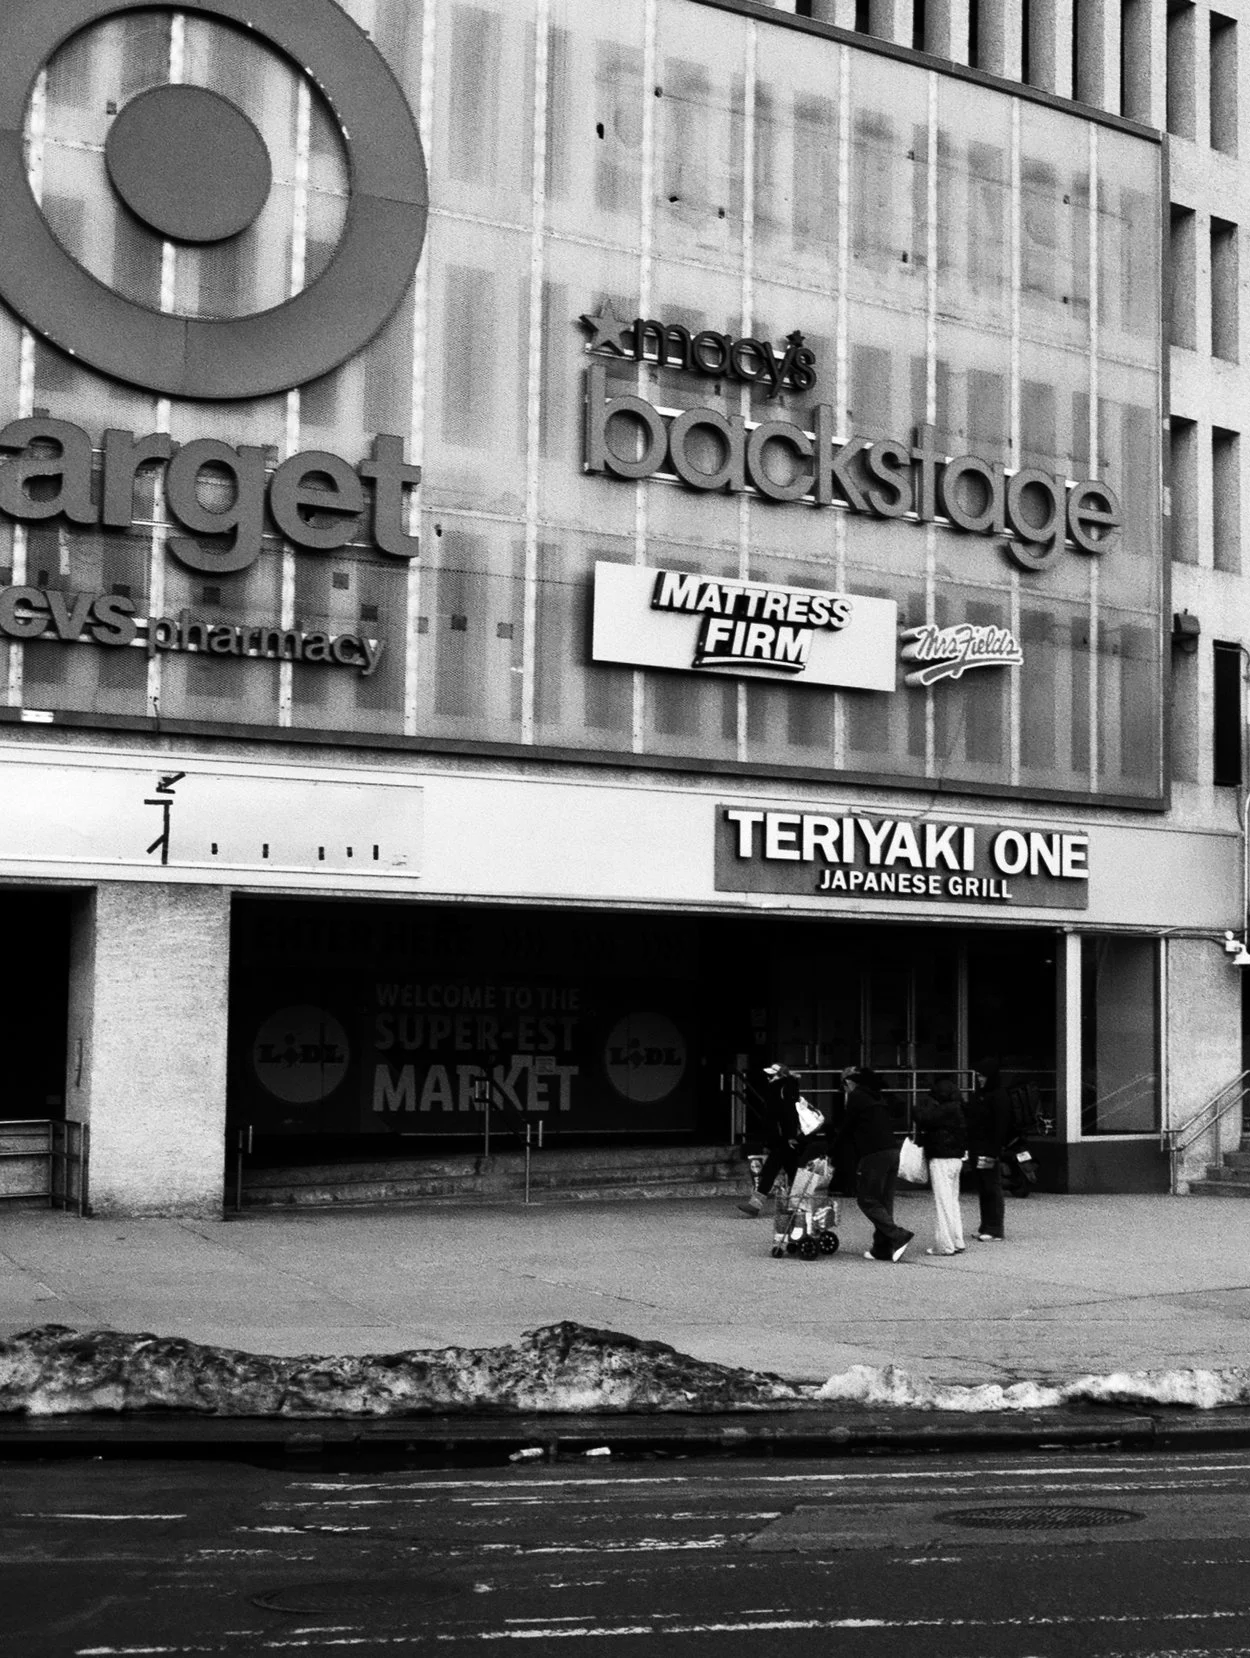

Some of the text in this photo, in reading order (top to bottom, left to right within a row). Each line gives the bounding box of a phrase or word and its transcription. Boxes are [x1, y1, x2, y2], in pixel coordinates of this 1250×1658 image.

[632, 318, 817, 398] macy's
[583, 363, 1121, 571] backstage
[659, 572, 853, 628] MATTRESS
[147, 608, 388, 675] pharmacy
[704, 617, 814, 663] FIRM
[952, 625, 1020, 676] Fields
[728, 810, 1089, 878] TERIYAKI ONE
[820, 870, 1013, 898] JAPANESE GRILL
[375, 983, 580, 1011] WELCOME TO THE
[374, 1012, 579, 1052] SUPER-EST
[372, 1056, 580, 1112] MARKET
